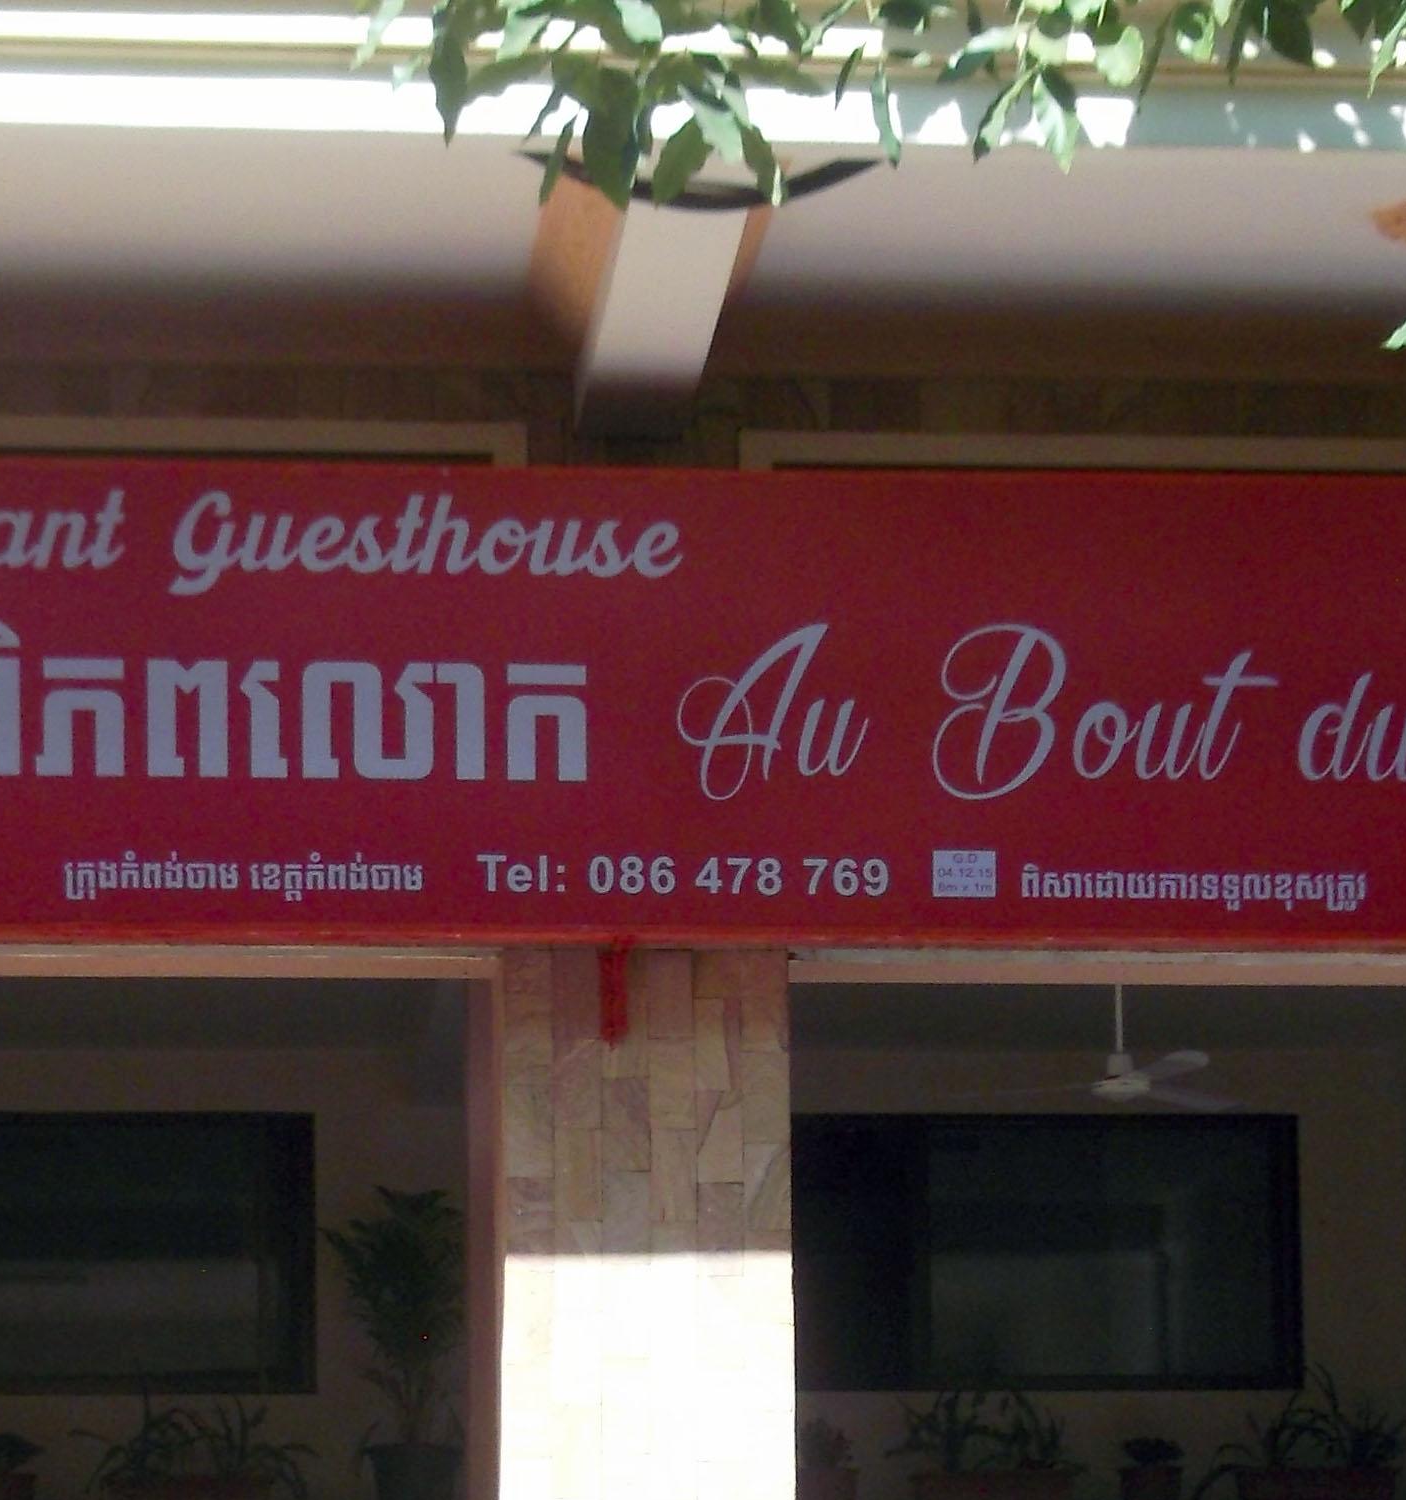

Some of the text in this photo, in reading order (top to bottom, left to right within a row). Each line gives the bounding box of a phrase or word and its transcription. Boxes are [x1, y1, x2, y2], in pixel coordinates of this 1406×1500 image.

[168, 490, 683, 596] Guesthouse
[676, 622, 869, 801] Au
[931, 622, 1277, 801] Bout
[476, 853, 889, 897] Tel: 086 478 769
